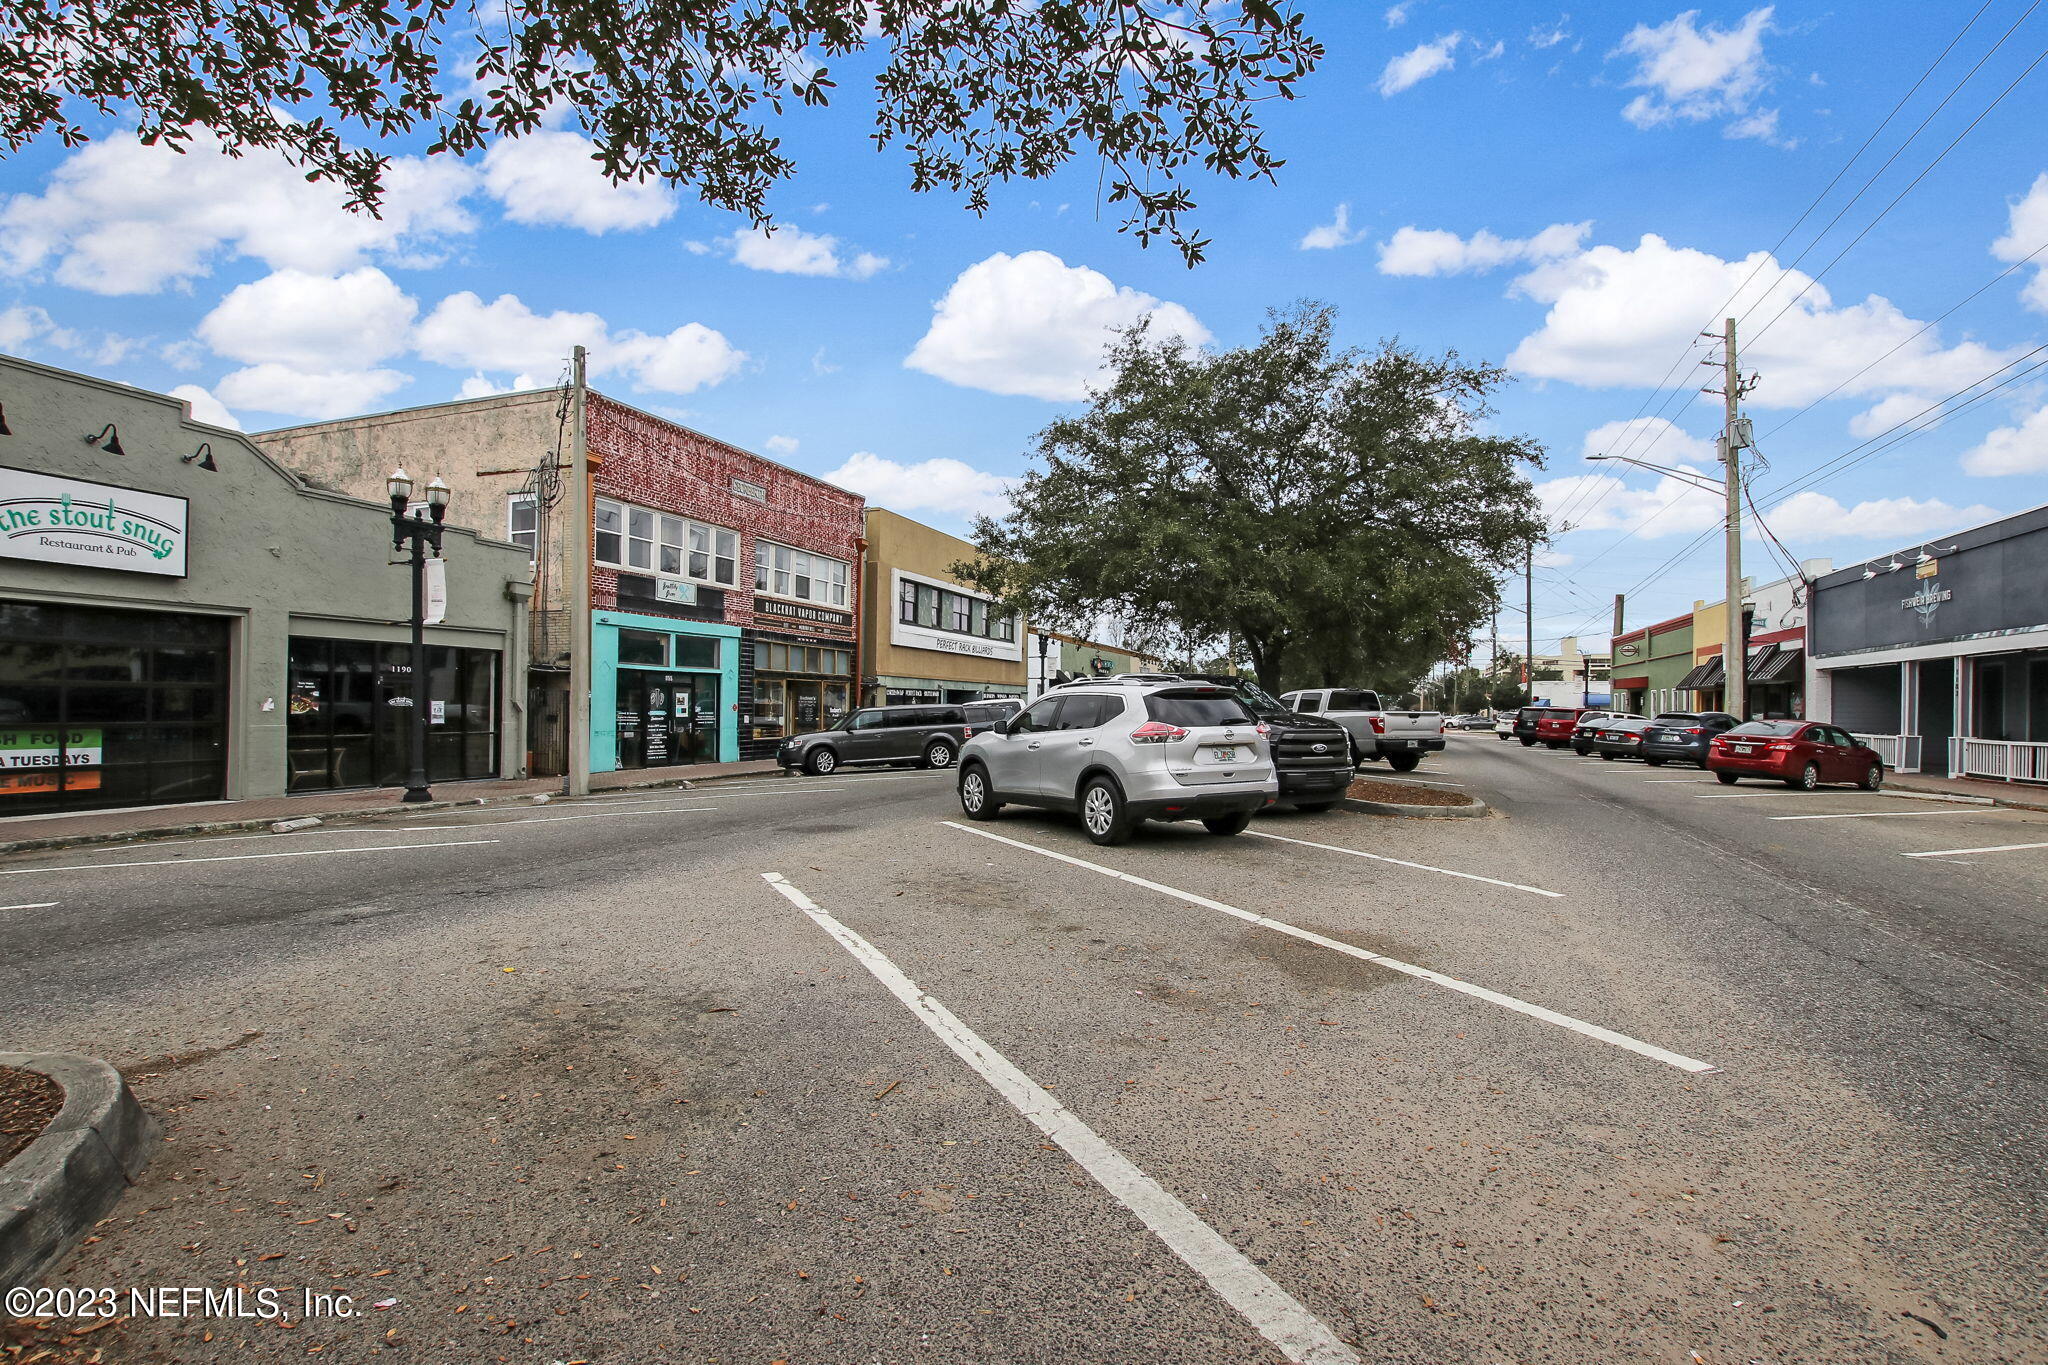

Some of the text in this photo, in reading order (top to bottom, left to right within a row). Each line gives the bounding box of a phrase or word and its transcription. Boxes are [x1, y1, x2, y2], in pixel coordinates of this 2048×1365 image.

[0, 493, 174, 559] the stout snug
[39, 536, 137, 557] Restaurant & Pub
[765, 602, 843, 624] BLACKHAT VAPOR COMPANY
[936, 638, 958, 650] PERFECT
[959, 642, 971, 652] RACK
[18, 775, 75, 788] MUSC
